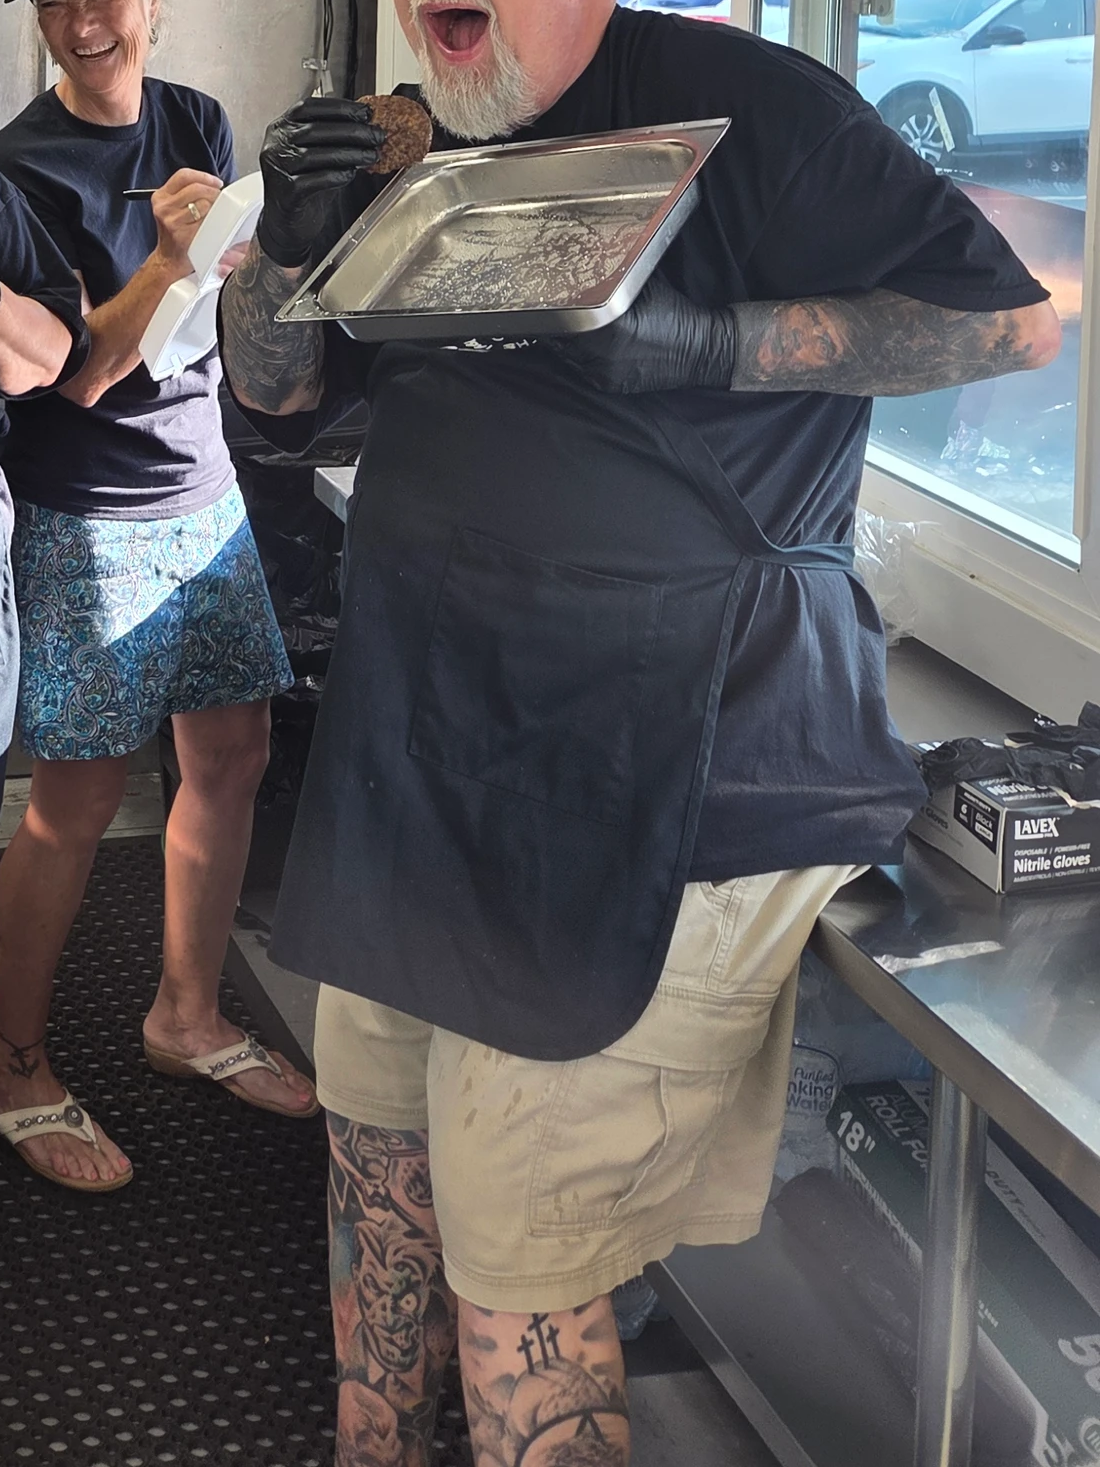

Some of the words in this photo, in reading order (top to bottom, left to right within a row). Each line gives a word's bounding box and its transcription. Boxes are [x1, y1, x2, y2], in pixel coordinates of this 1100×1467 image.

[960, 803, 968, 815] 6
[975, 812, 993, 830] Black
[1014, 817, 1059, 840] LAVEX
[1014, 847, 1048, 857] DISPOSABLE
[1013, 856, 1051, 874] Nitrile
[1052, 854, 1091, 869] Gloves
[794, 1067, 835, 1083] Purified
[788, 1081, 834, 1100] nking
[866, 1094, 911, 1138] ROLL
[837, 1110, 876, 1153] 18"
